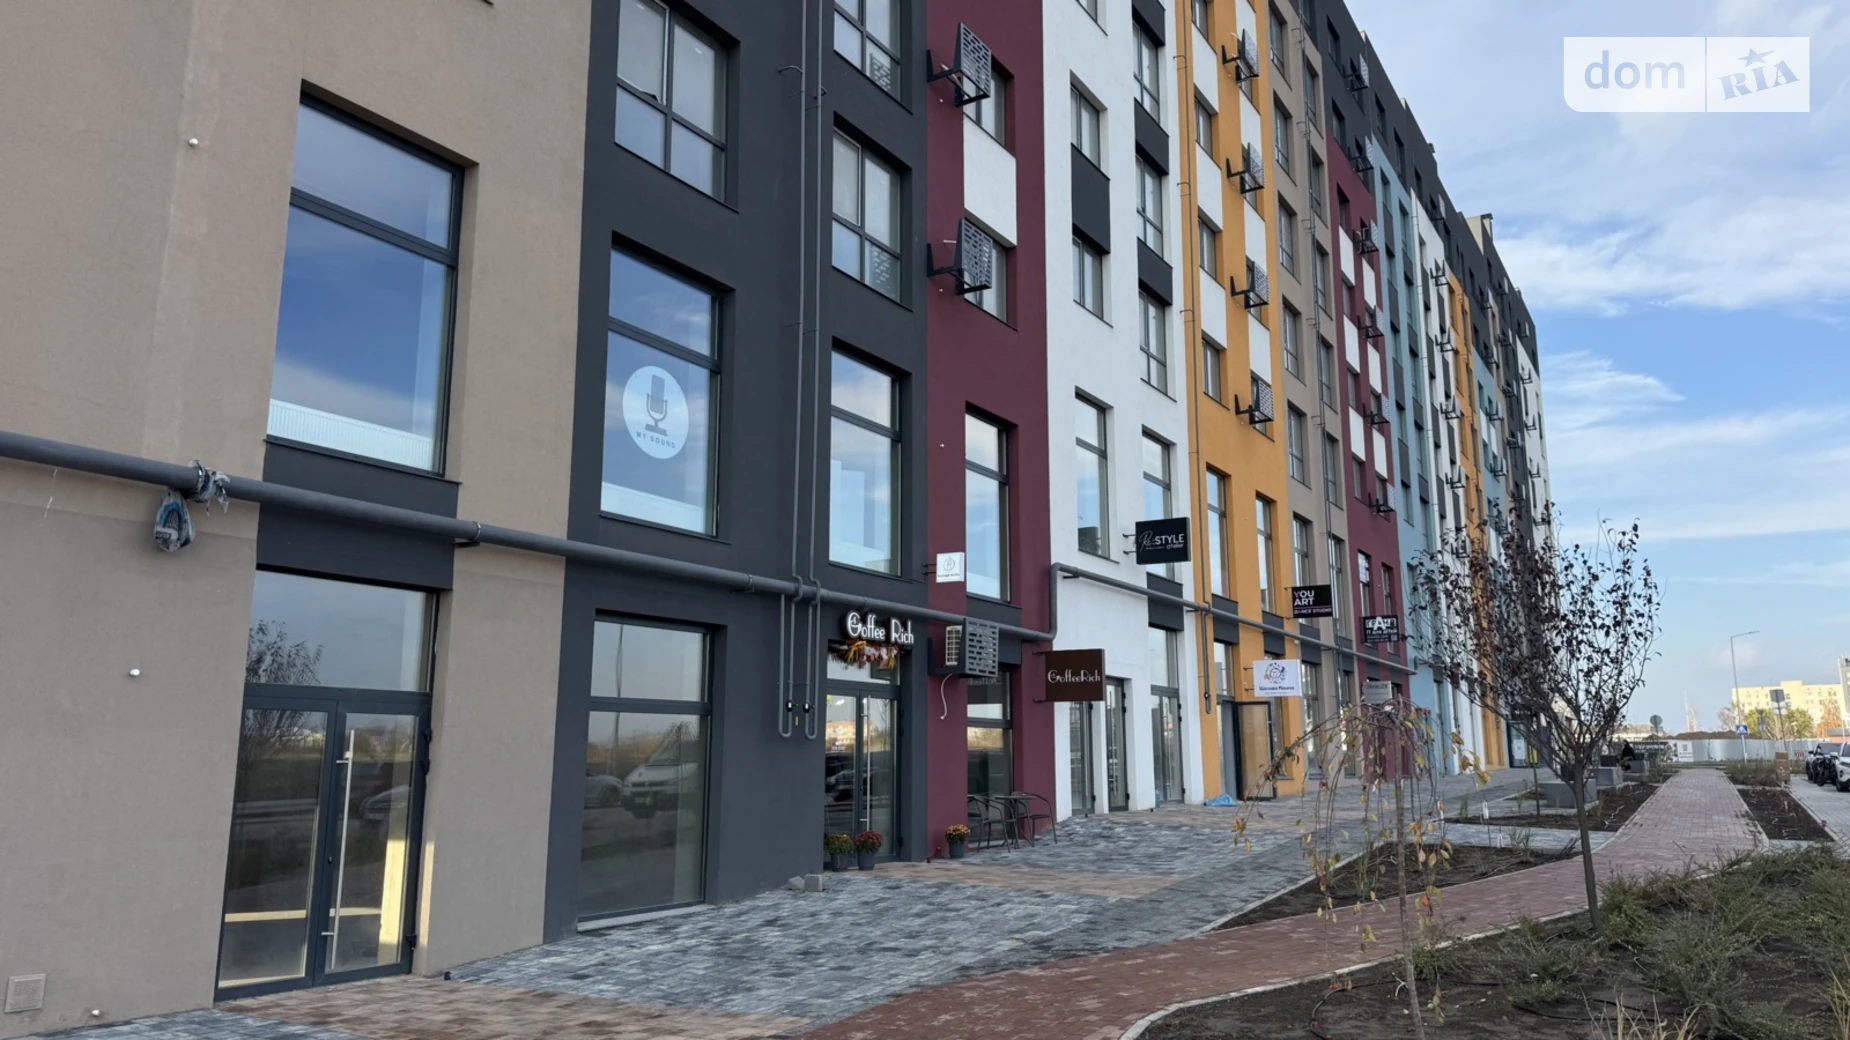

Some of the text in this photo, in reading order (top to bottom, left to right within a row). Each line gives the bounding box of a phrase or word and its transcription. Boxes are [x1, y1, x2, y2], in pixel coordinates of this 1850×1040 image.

[636, 431, 676, 449] MY SOUND
[1294, 590, 1314, 598] YOU
[1294, 597, 1314, 606] ART
[891, 618, 914, 643] Rich
